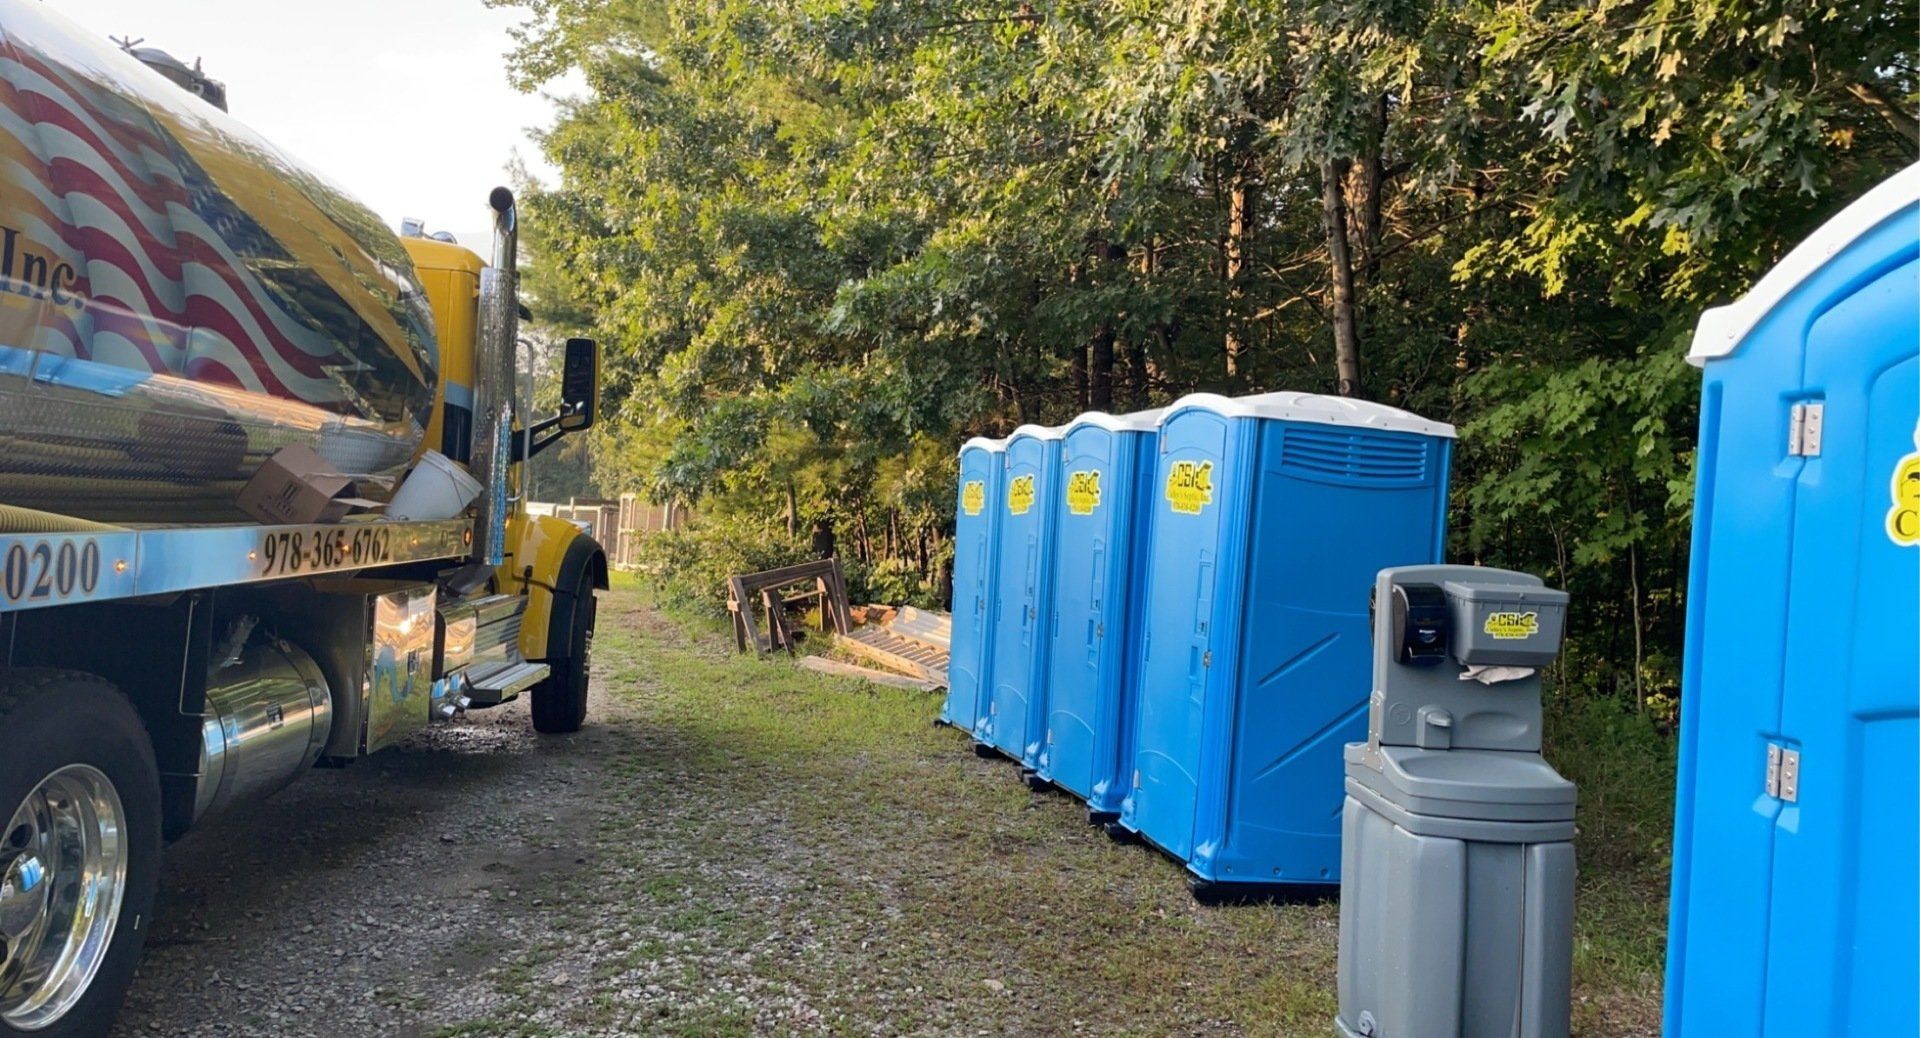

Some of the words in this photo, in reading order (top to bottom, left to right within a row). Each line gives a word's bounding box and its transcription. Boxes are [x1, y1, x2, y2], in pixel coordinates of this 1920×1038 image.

[0, 226, 84, 310] Inc.
[263, 528, 390, 576] 978-365-6762
[1499, 613, 1519, 626] CSI
